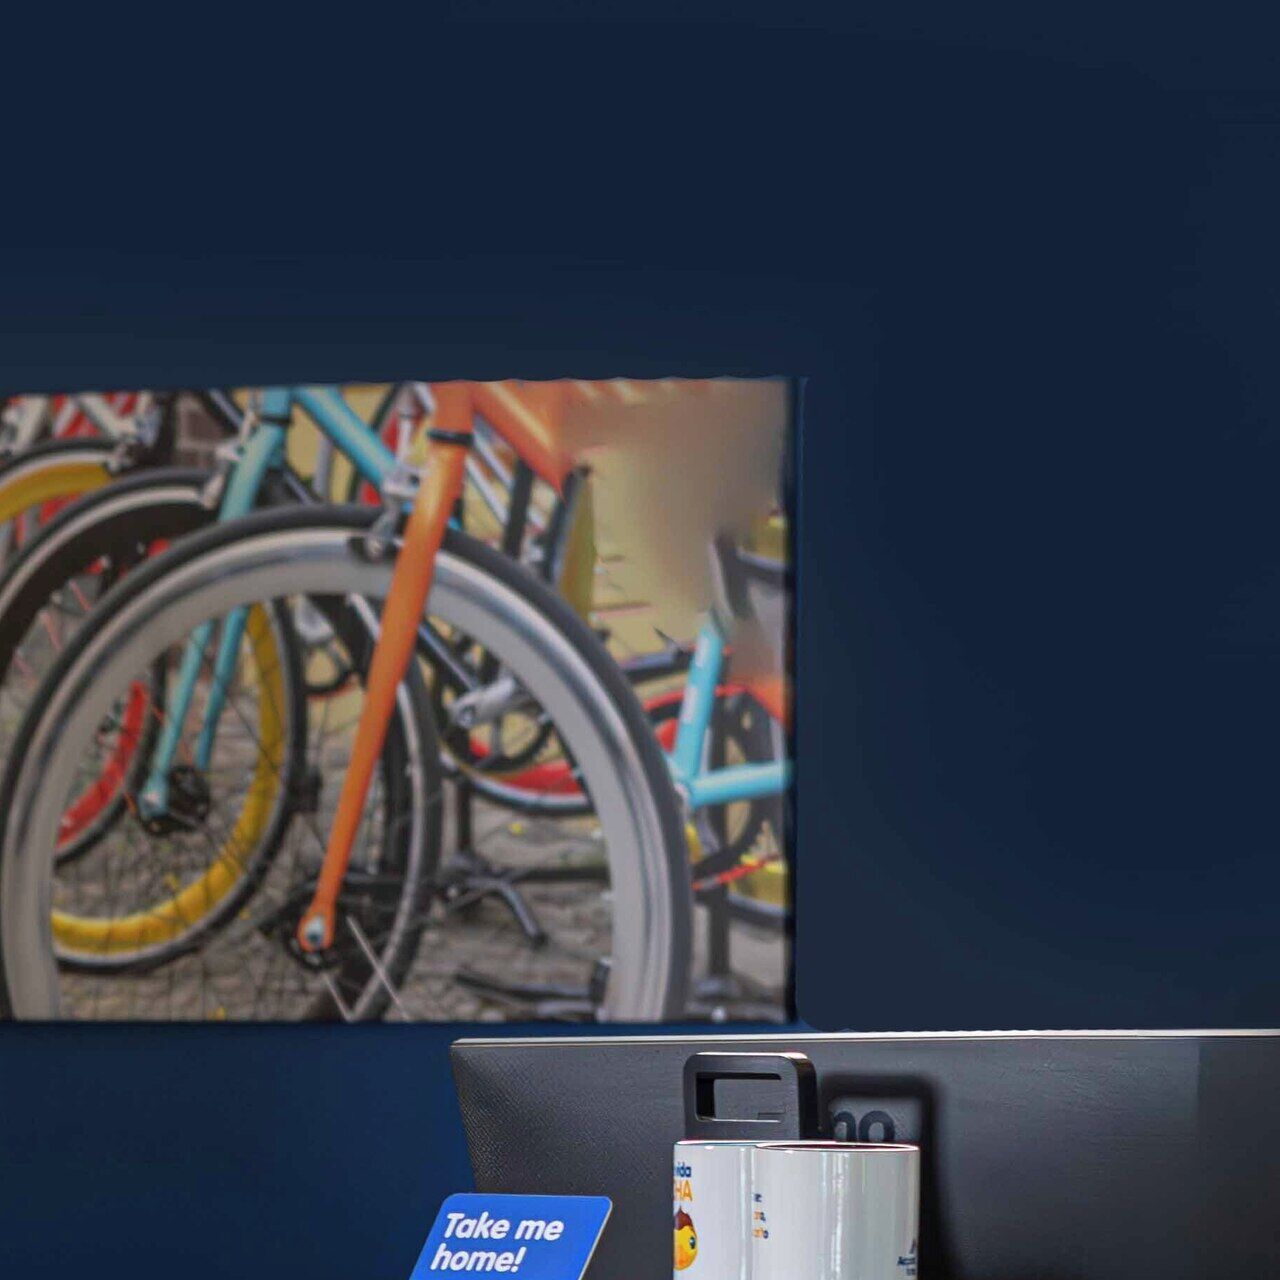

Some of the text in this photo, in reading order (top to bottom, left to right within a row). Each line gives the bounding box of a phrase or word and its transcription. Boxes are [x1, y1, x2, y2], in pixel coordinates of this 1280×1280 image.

[443, 1211, 565, 1241] Take me
[430, 1243, 528, 1273] home!
